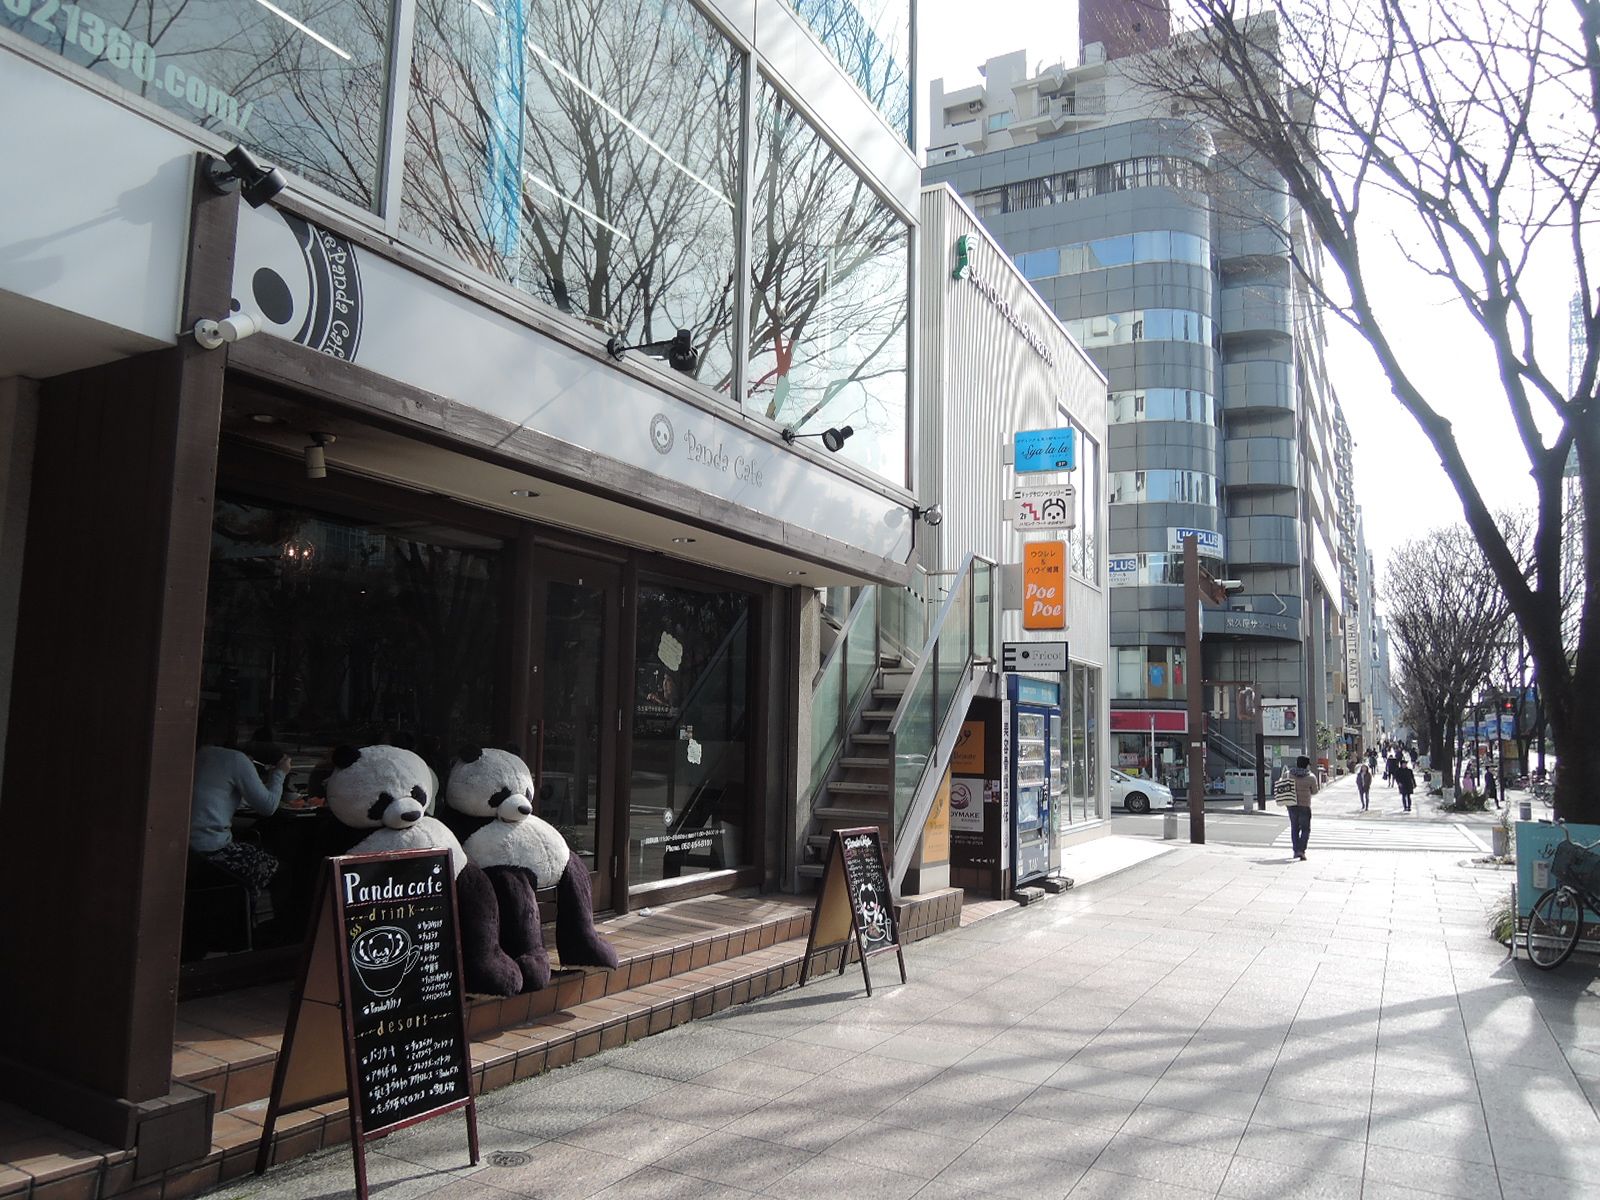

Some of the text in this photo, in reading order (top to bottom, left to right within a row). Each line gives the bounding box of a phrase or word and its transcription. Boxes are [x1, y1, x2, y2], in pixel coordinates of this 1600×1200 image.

[684, 429, 729, 472] Panda
[1026, 584, 1056, 600] Poe
[1032, 600, 1062, 617] Poe
[344, 872, 442, 904] Panda cafe
[369, 904, 415, 921] drink
